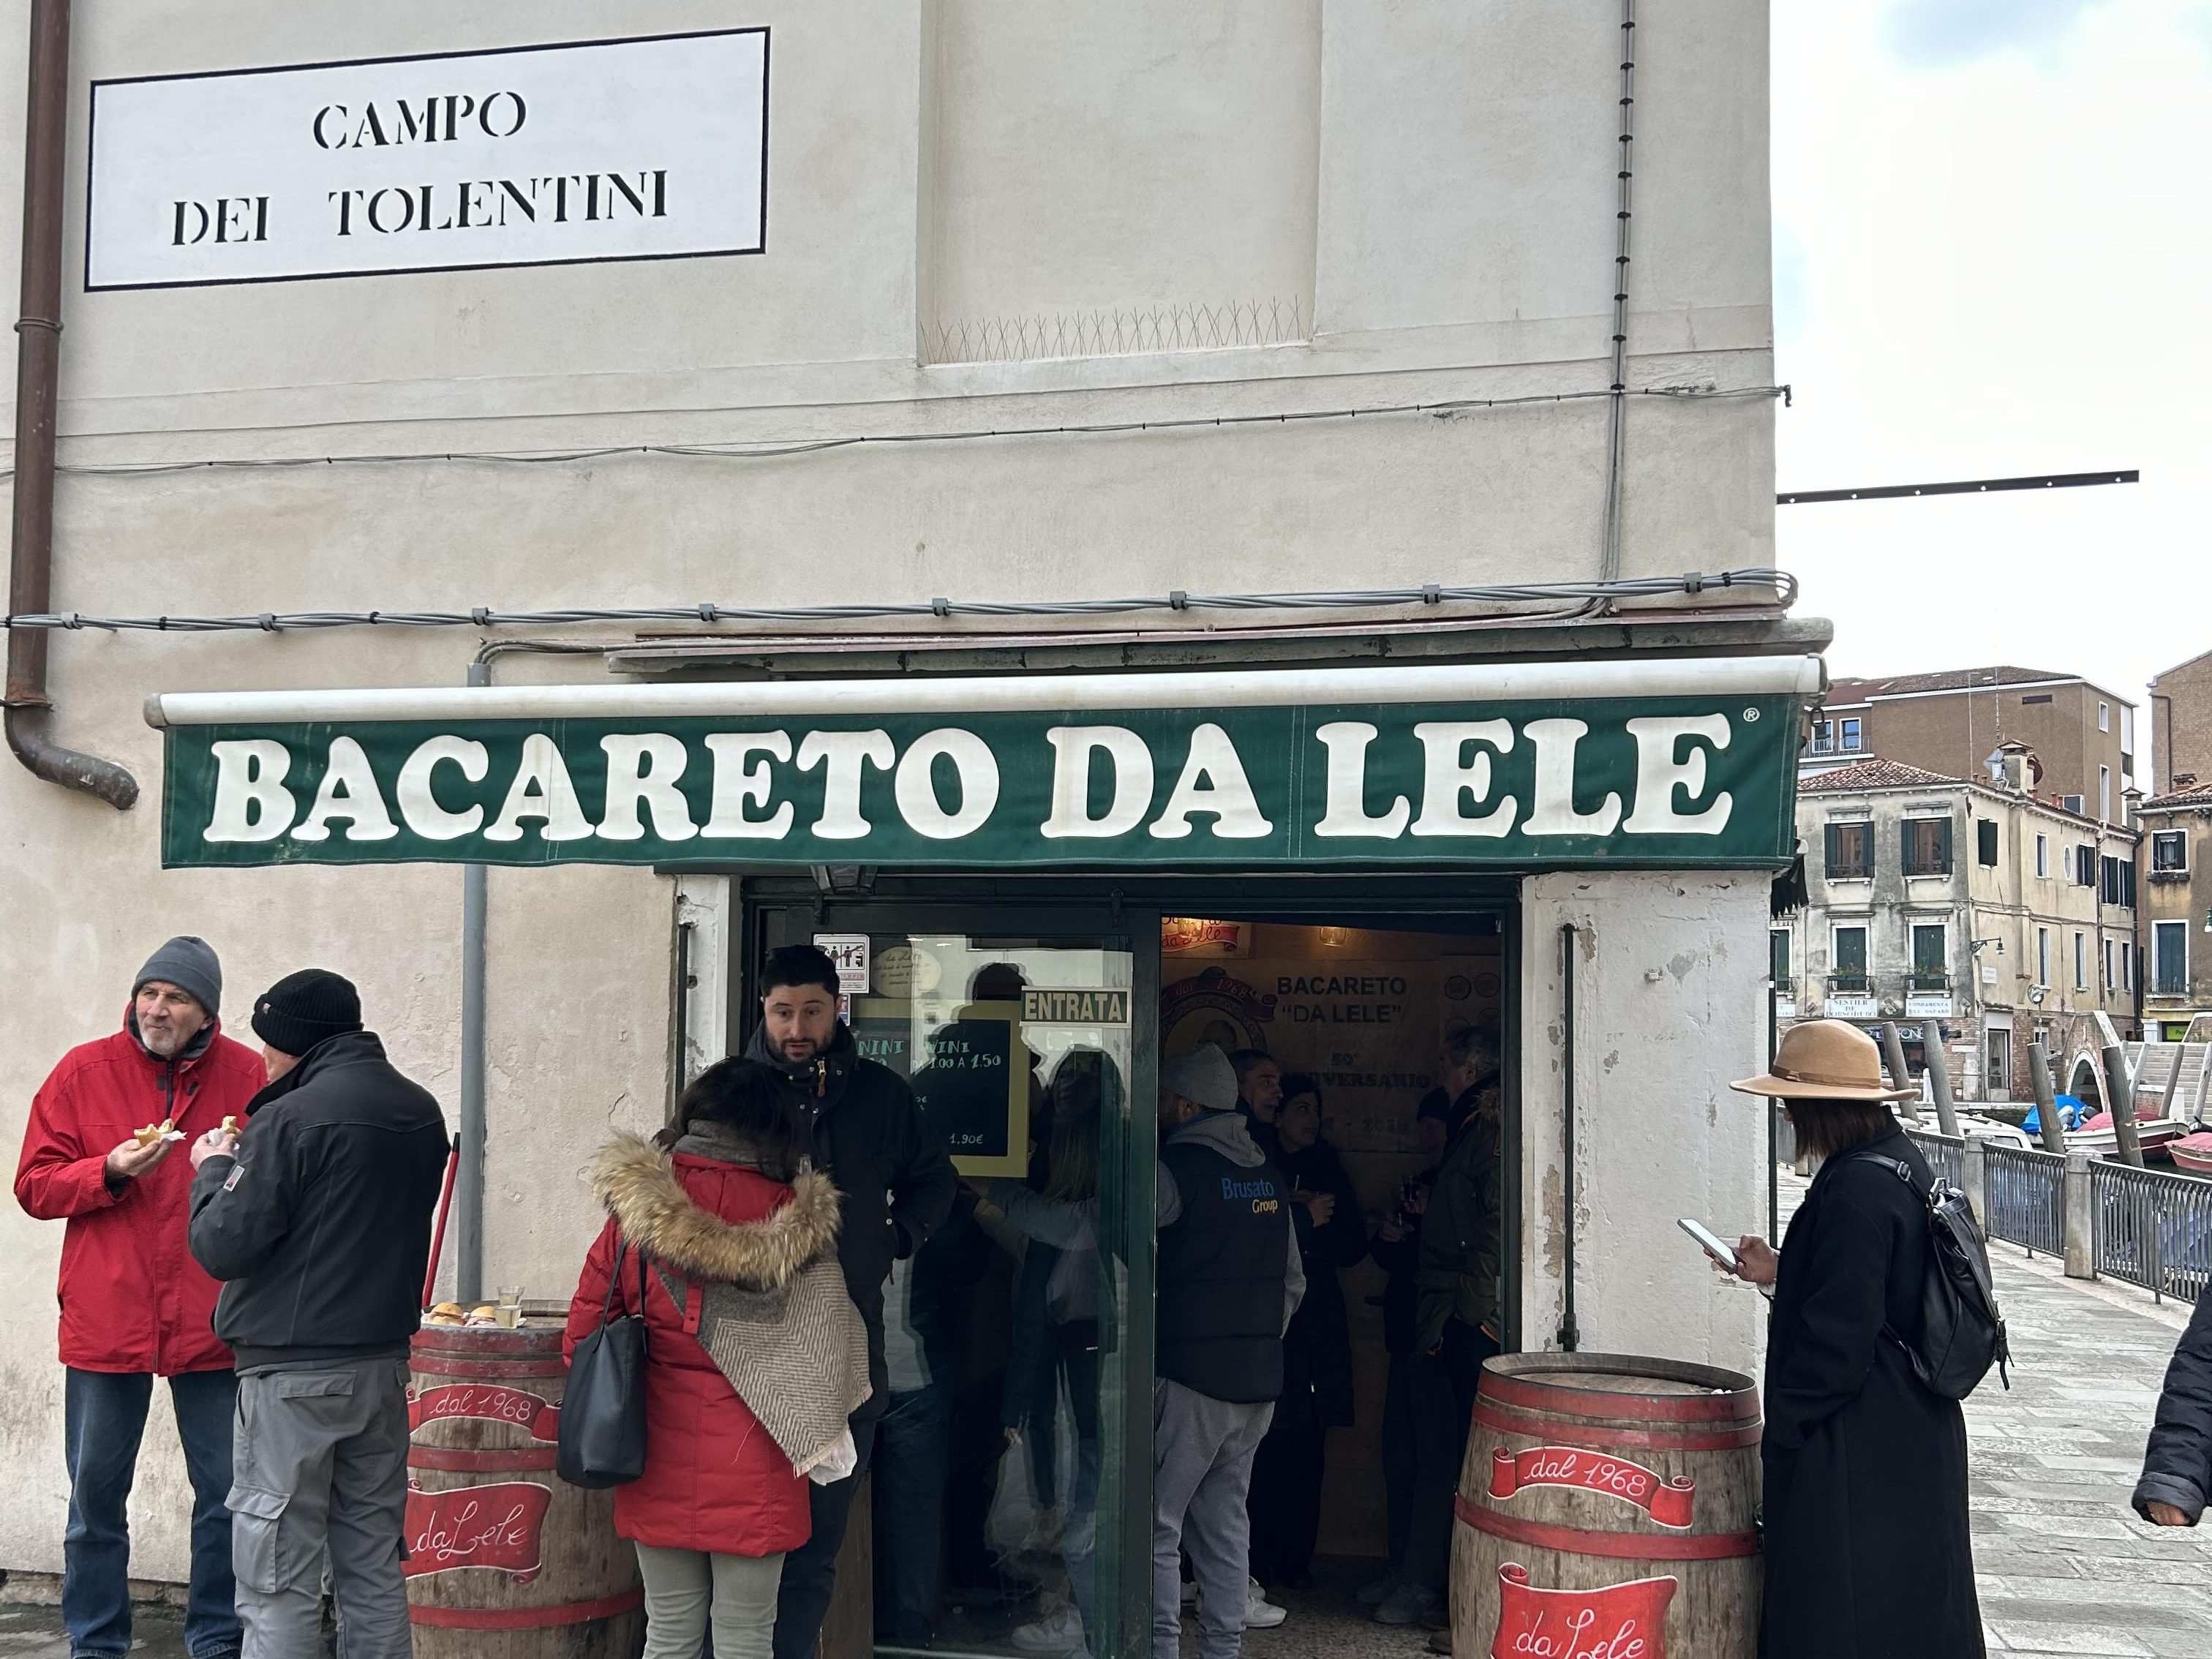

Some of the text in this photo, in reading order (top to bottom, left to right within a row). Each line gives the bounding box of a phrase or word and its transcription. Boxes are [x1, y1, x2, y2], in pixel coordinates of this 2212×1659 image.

[312, 91, 527, 151] CAMPO
[171, 170, 669, 247] DEI TOLENTINI
[203, 728, 1001, 843] BACARETO
[1040, 723, 1274, 840] DA
[1314, 712, 1734, 840] LELE
[1277, 977, 1407, 996] BACARETO
[1025, 991, 1123, 1023] ENTRATA
[857, 1039, 905, 1056] NINI
[925, 1039, 971, 1054] VINI
[958, 1058, 965, 1068] A
[971, 1053, 1001, 1069] 1.50
[1222, 1177, 1274, 1200] Brusato
[1252, 1199, 1278, 1214] Group
[430, 1390, 532, 1421] dal 1968
[1524, 1453, 1647, 1497] dal 1968
[1512, 1609, 1562, 1658] da
